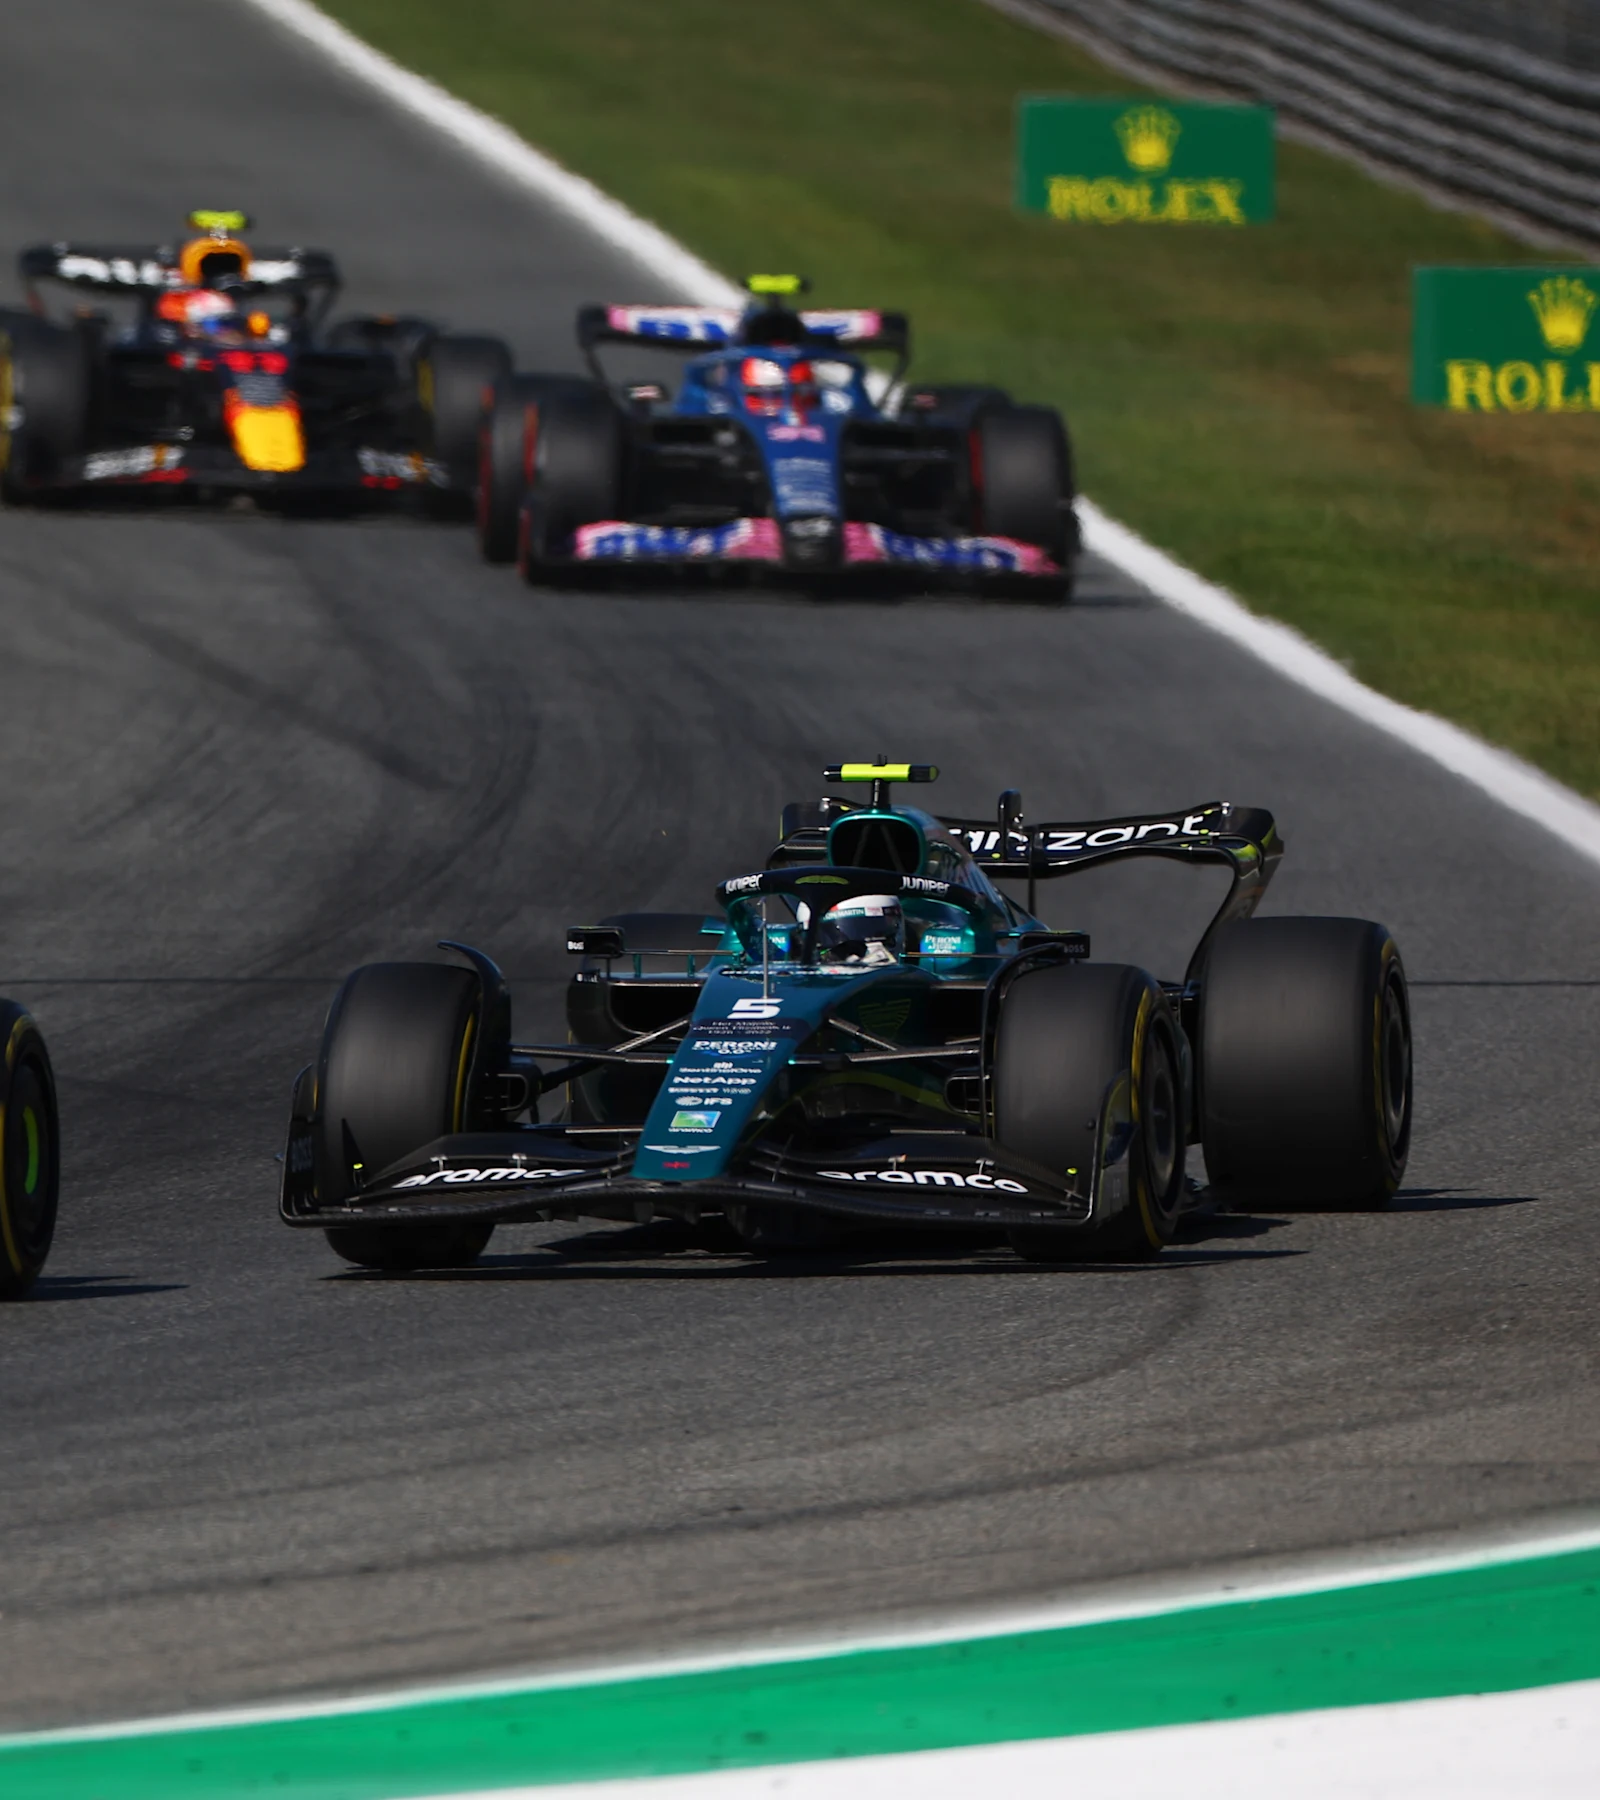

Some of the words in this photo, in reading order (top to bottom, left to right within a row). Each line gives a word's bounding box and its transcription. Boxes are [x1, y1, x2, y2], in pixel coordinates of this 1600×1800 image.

[1048, 175, 1244, 225] ROLEX
[727, 998, 784, 1020] 5
[693, 1040, 778, 1049] PERONI
[672, 1076, 757, 1086] NetApp
[703, 1097, 733, 1106] IFS
[391, 1167, 587, 1189] aramco
[816, 1170, 1029, 1194] aramco
